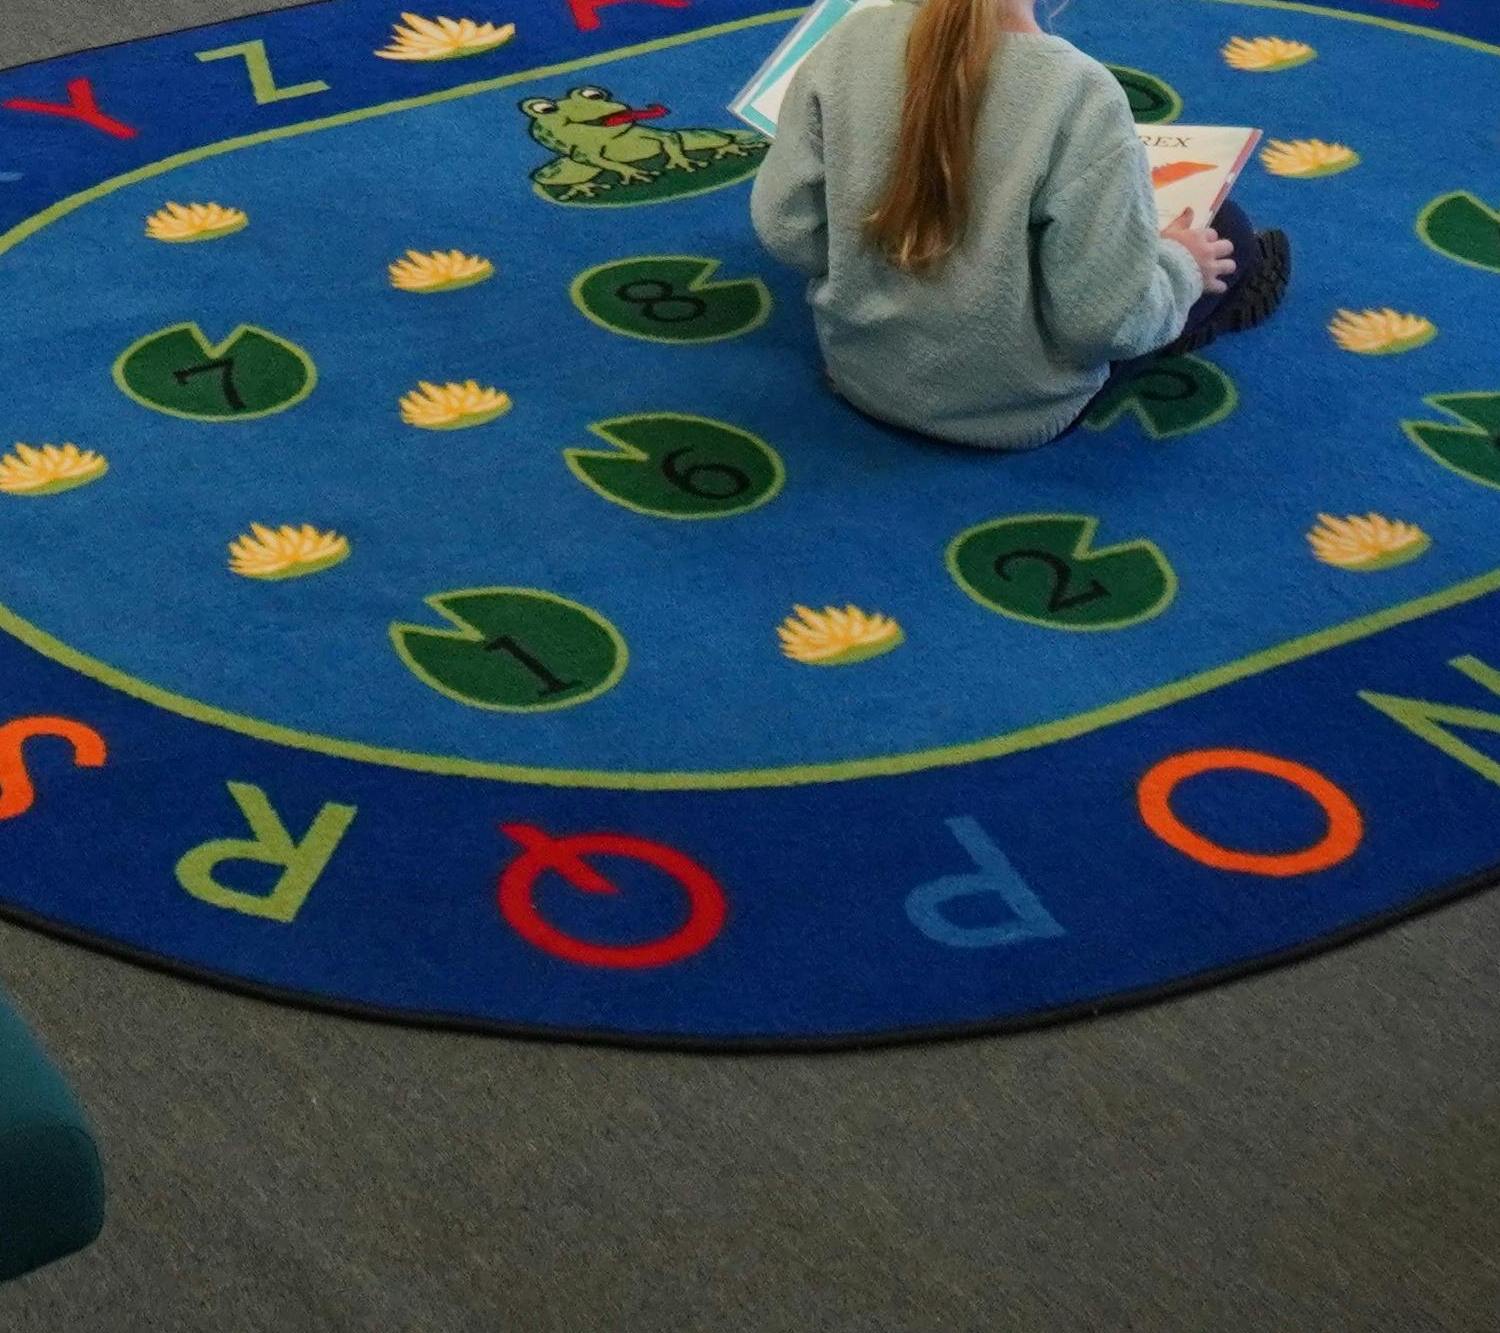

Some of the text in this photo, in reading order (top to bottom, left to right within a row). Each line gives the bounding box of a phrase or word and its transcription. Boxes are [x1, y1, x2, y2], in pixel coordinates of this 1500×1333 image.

[197, 39, 331, 105] Z
[1, 79, 137, 139] Y
[616, 279, 706, 323] 8
[173, 359, 244, 408] 7
[1012, 549, 1111, 611] 2
[484, 635, 581, 697] 1
[1137, 748, 1364, 876] O
[176, 782, 356, 921] R
[905, 815, 1066, 948] P
[497, 821, 727, 969] Q
